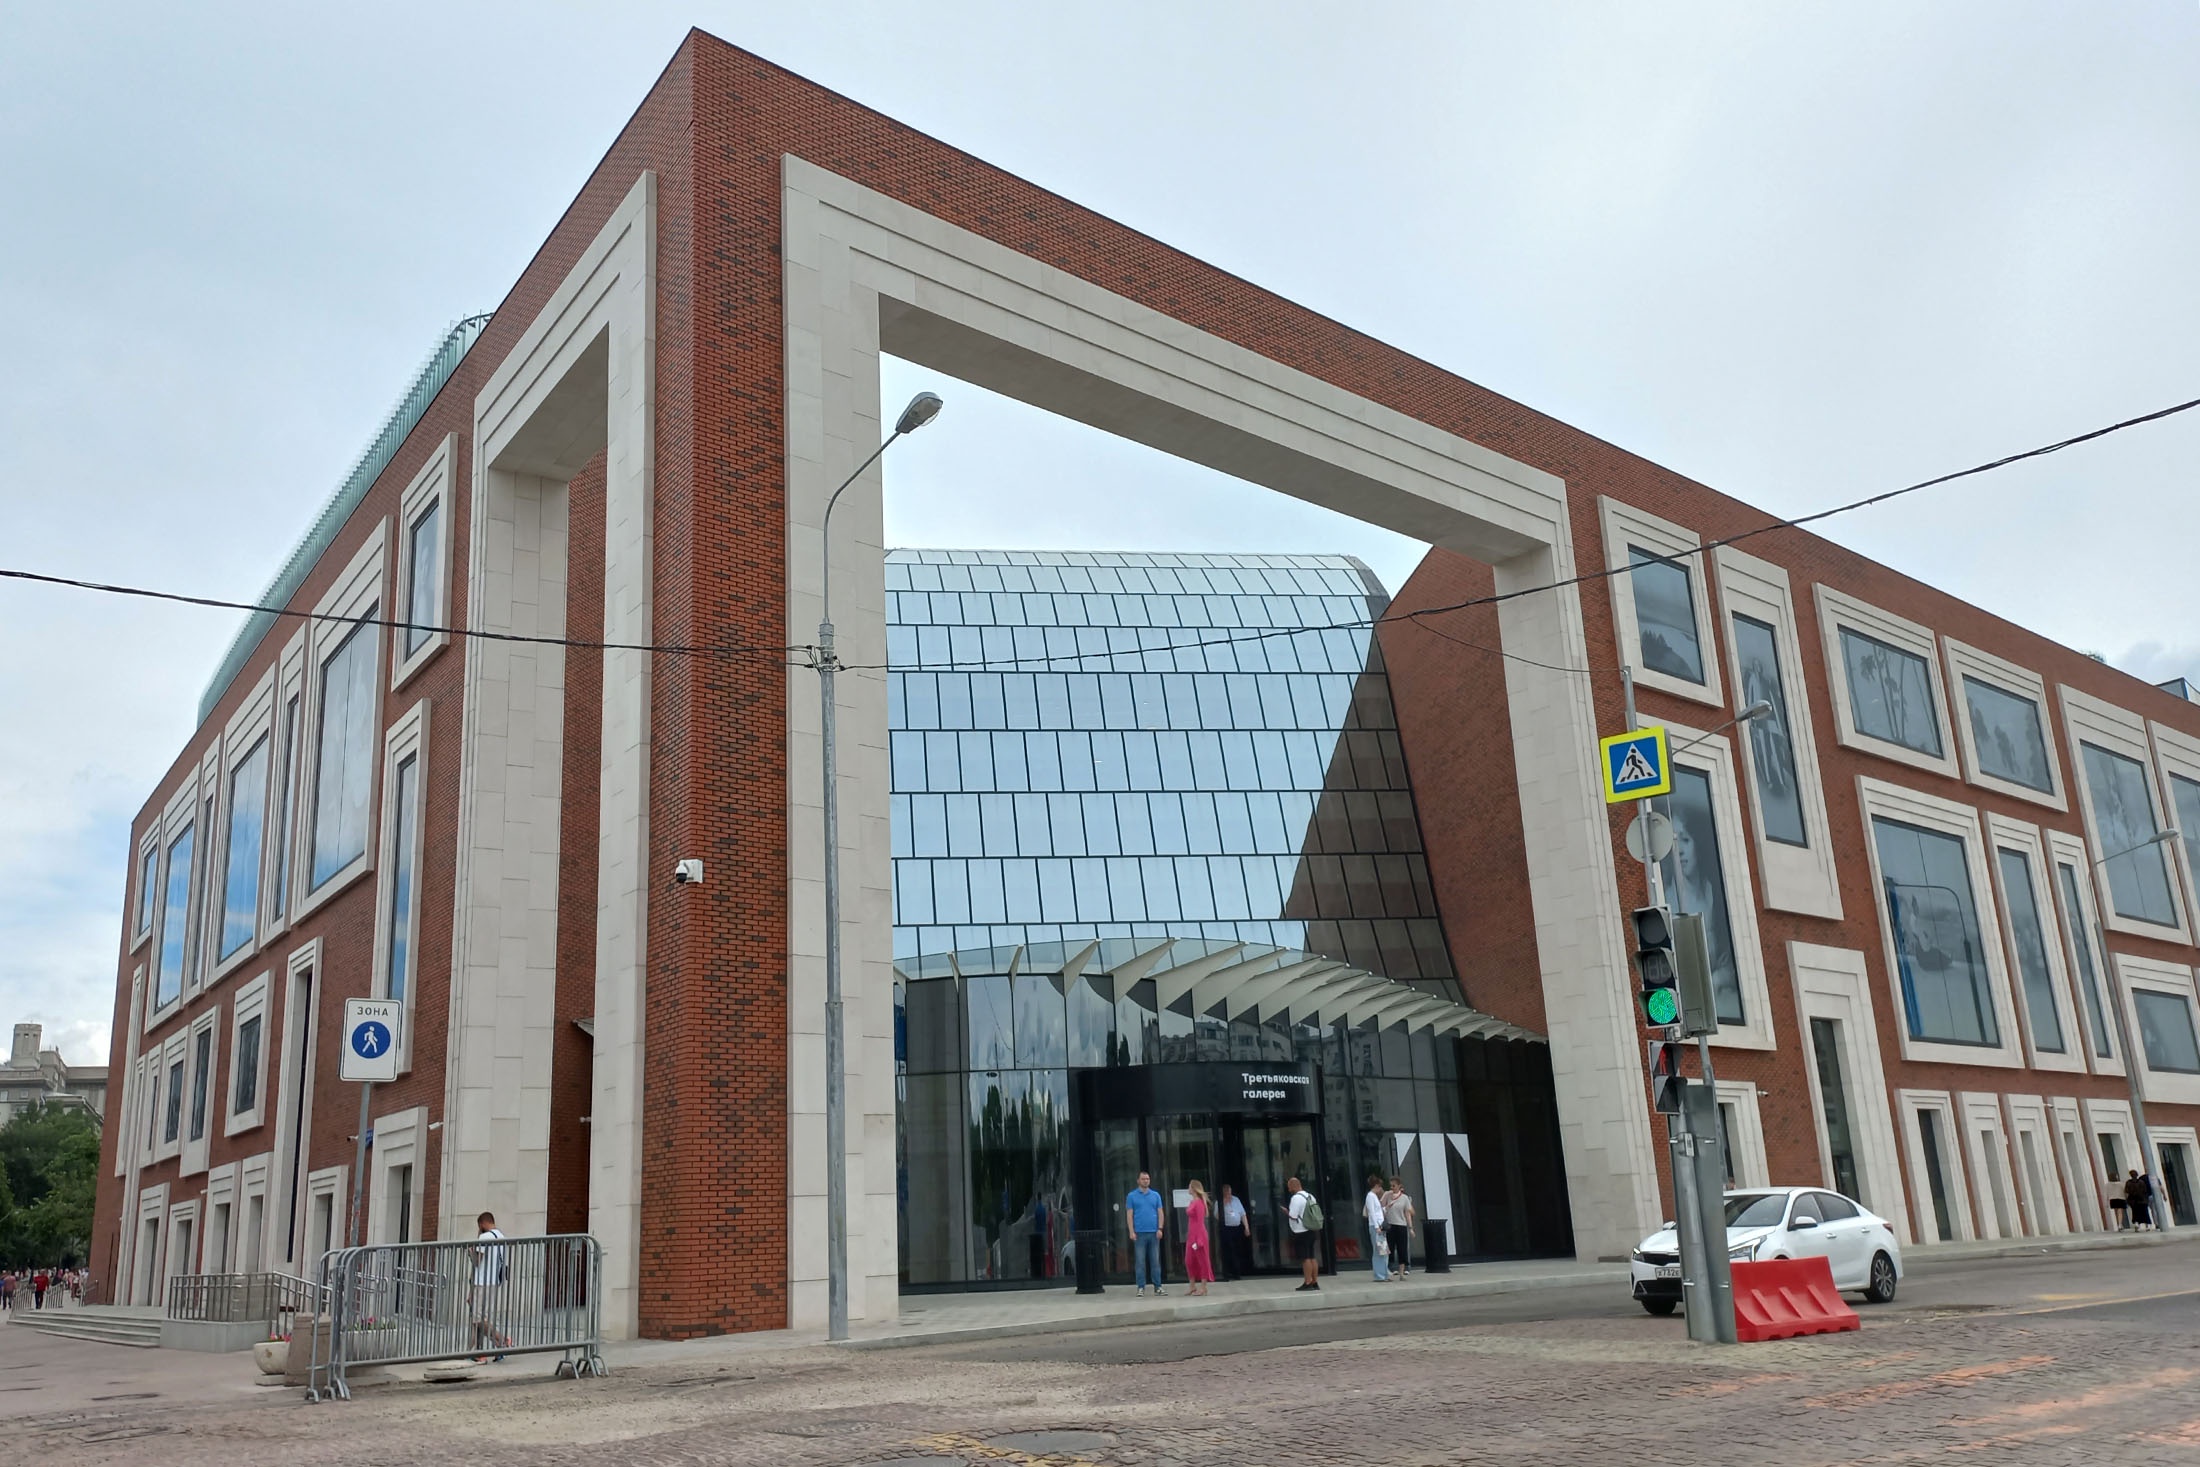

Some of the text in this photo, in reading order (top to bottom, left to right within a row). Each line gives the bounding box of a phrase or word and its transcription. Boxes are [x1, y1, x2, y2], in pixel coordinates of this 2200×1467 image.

[357, 1006, 388, 1016] ЗОНА
[1242, 1073, 1309, 1086] Третьяковская
[1243, 1090, 1285, 1101] галерея
